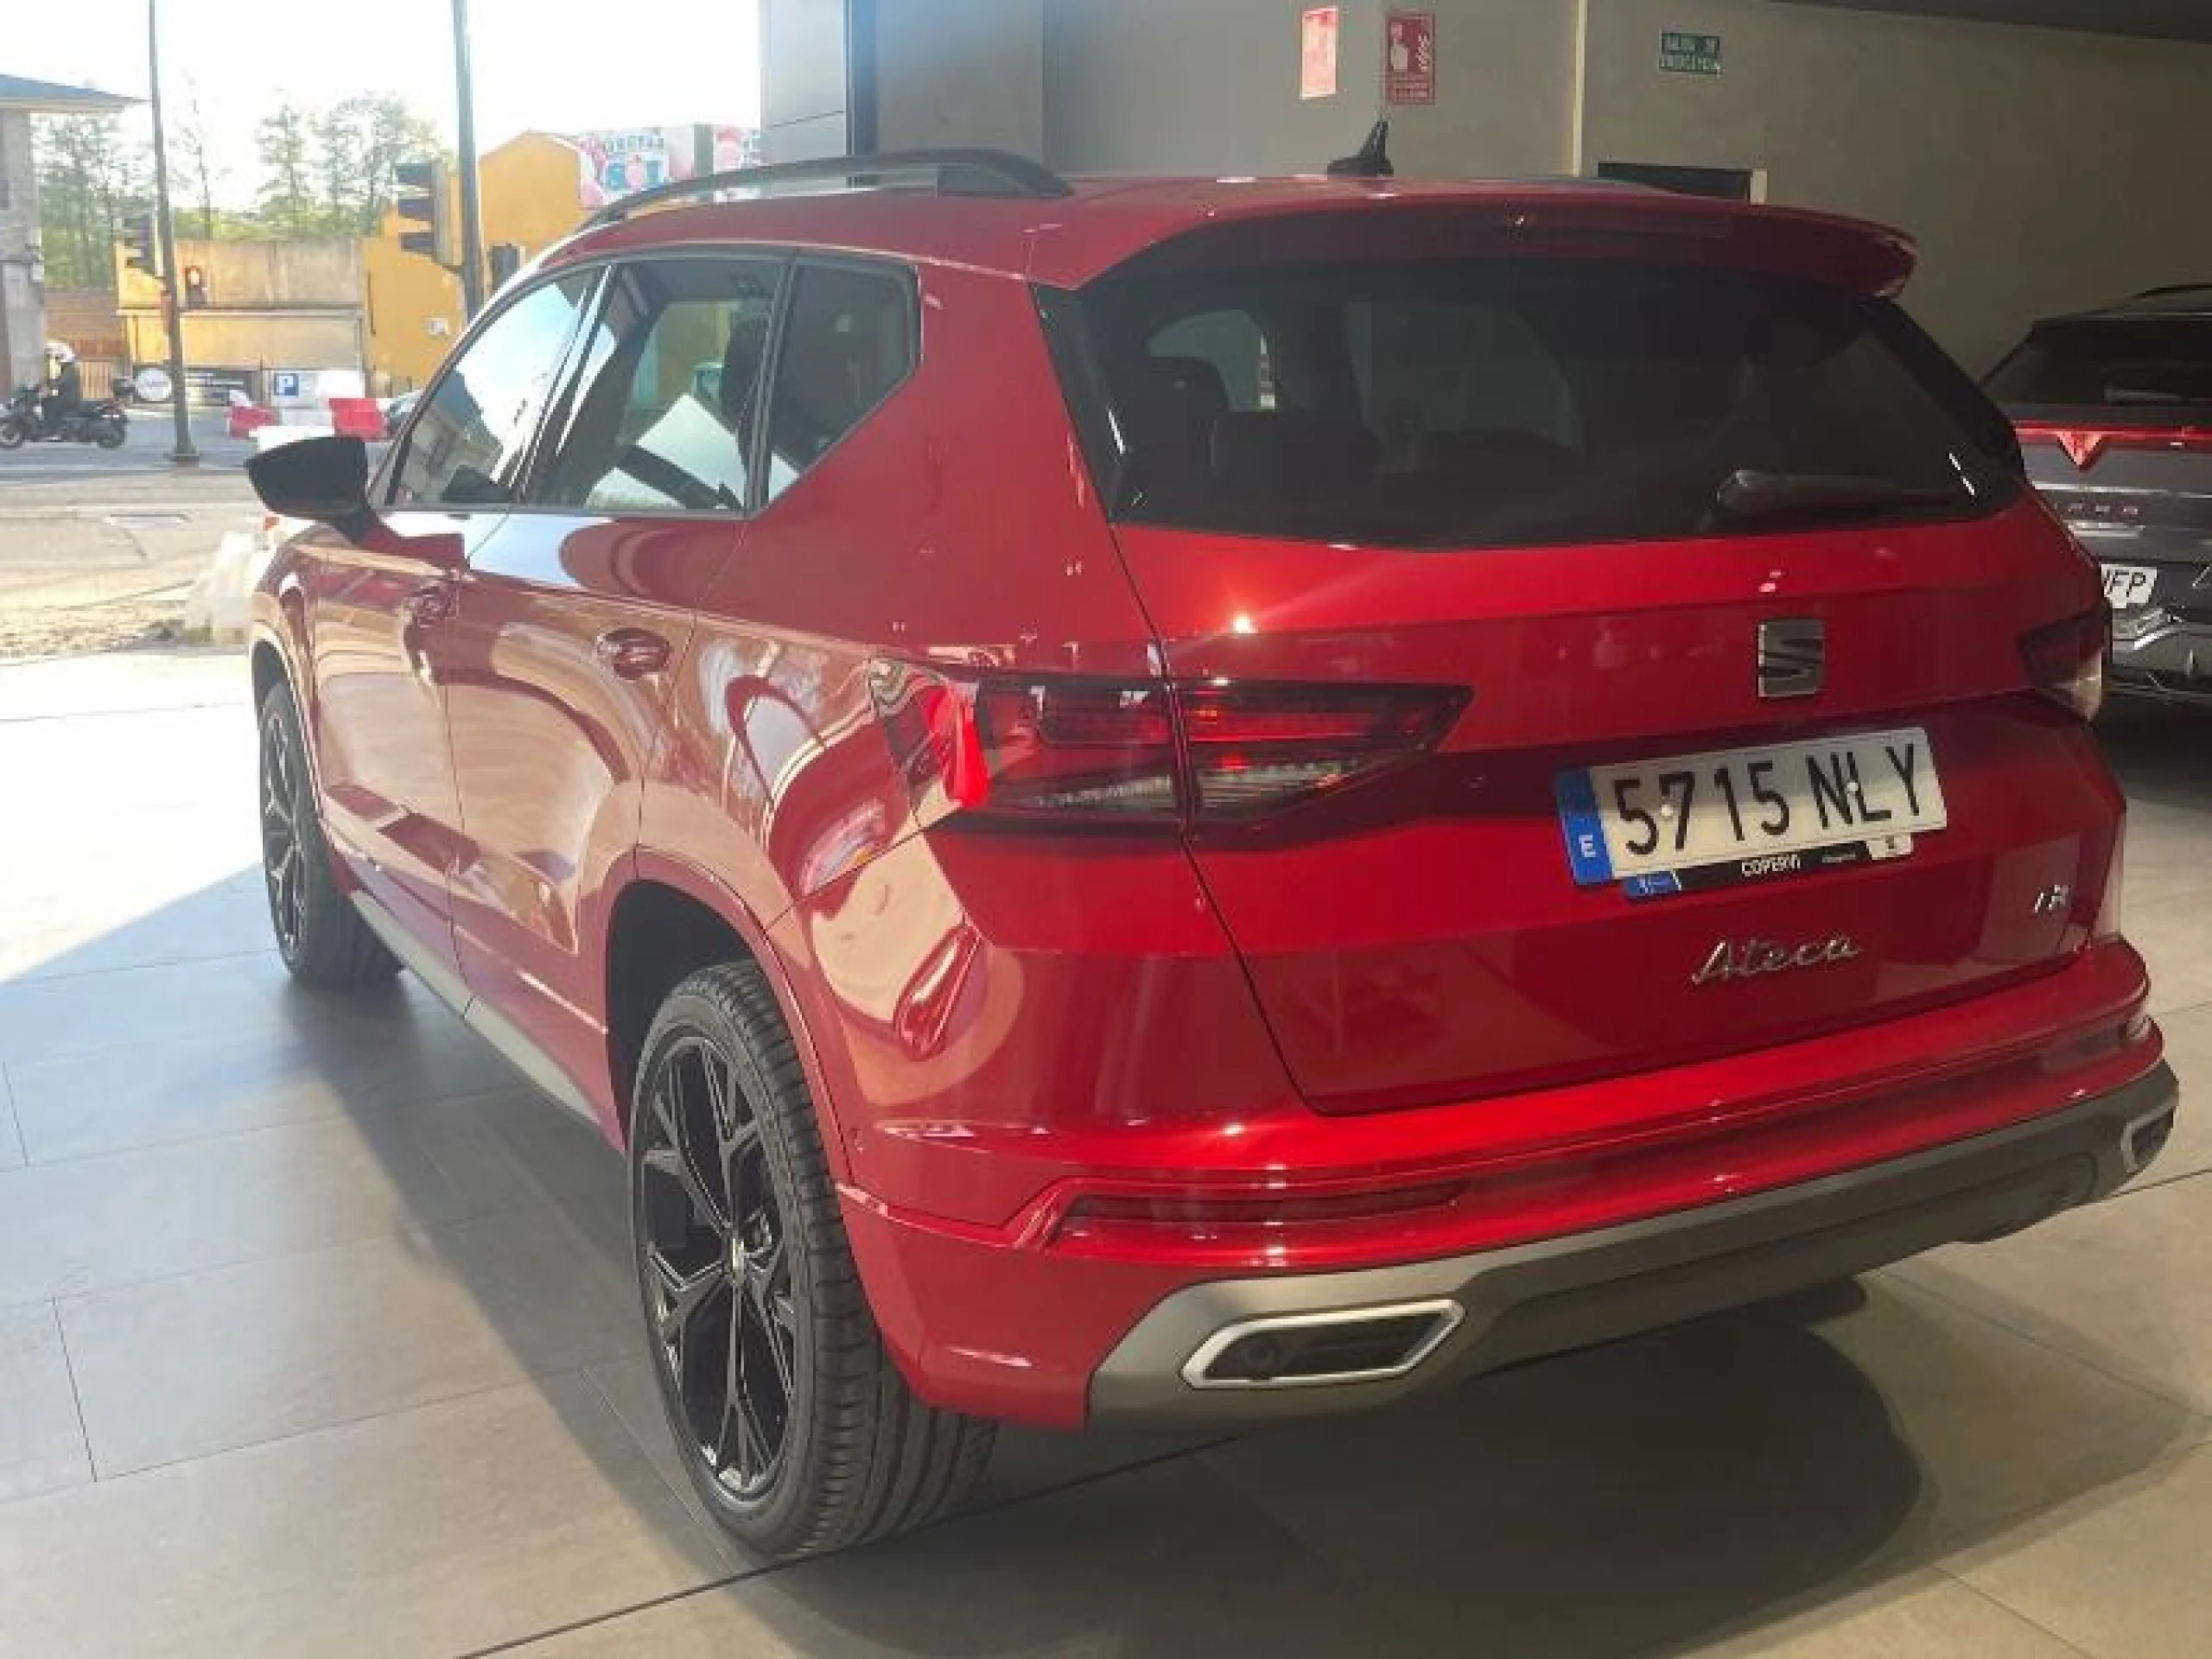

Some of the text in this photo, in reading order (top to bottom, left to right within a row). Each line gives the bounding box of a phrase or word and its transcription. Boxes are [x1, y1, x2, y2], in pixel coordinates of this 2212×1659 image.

[1613, 743, 1920, 855] 5715 NLY
[1578, 834, 1596, 858] E
[1691, 936, 1864, 985] Ateca
